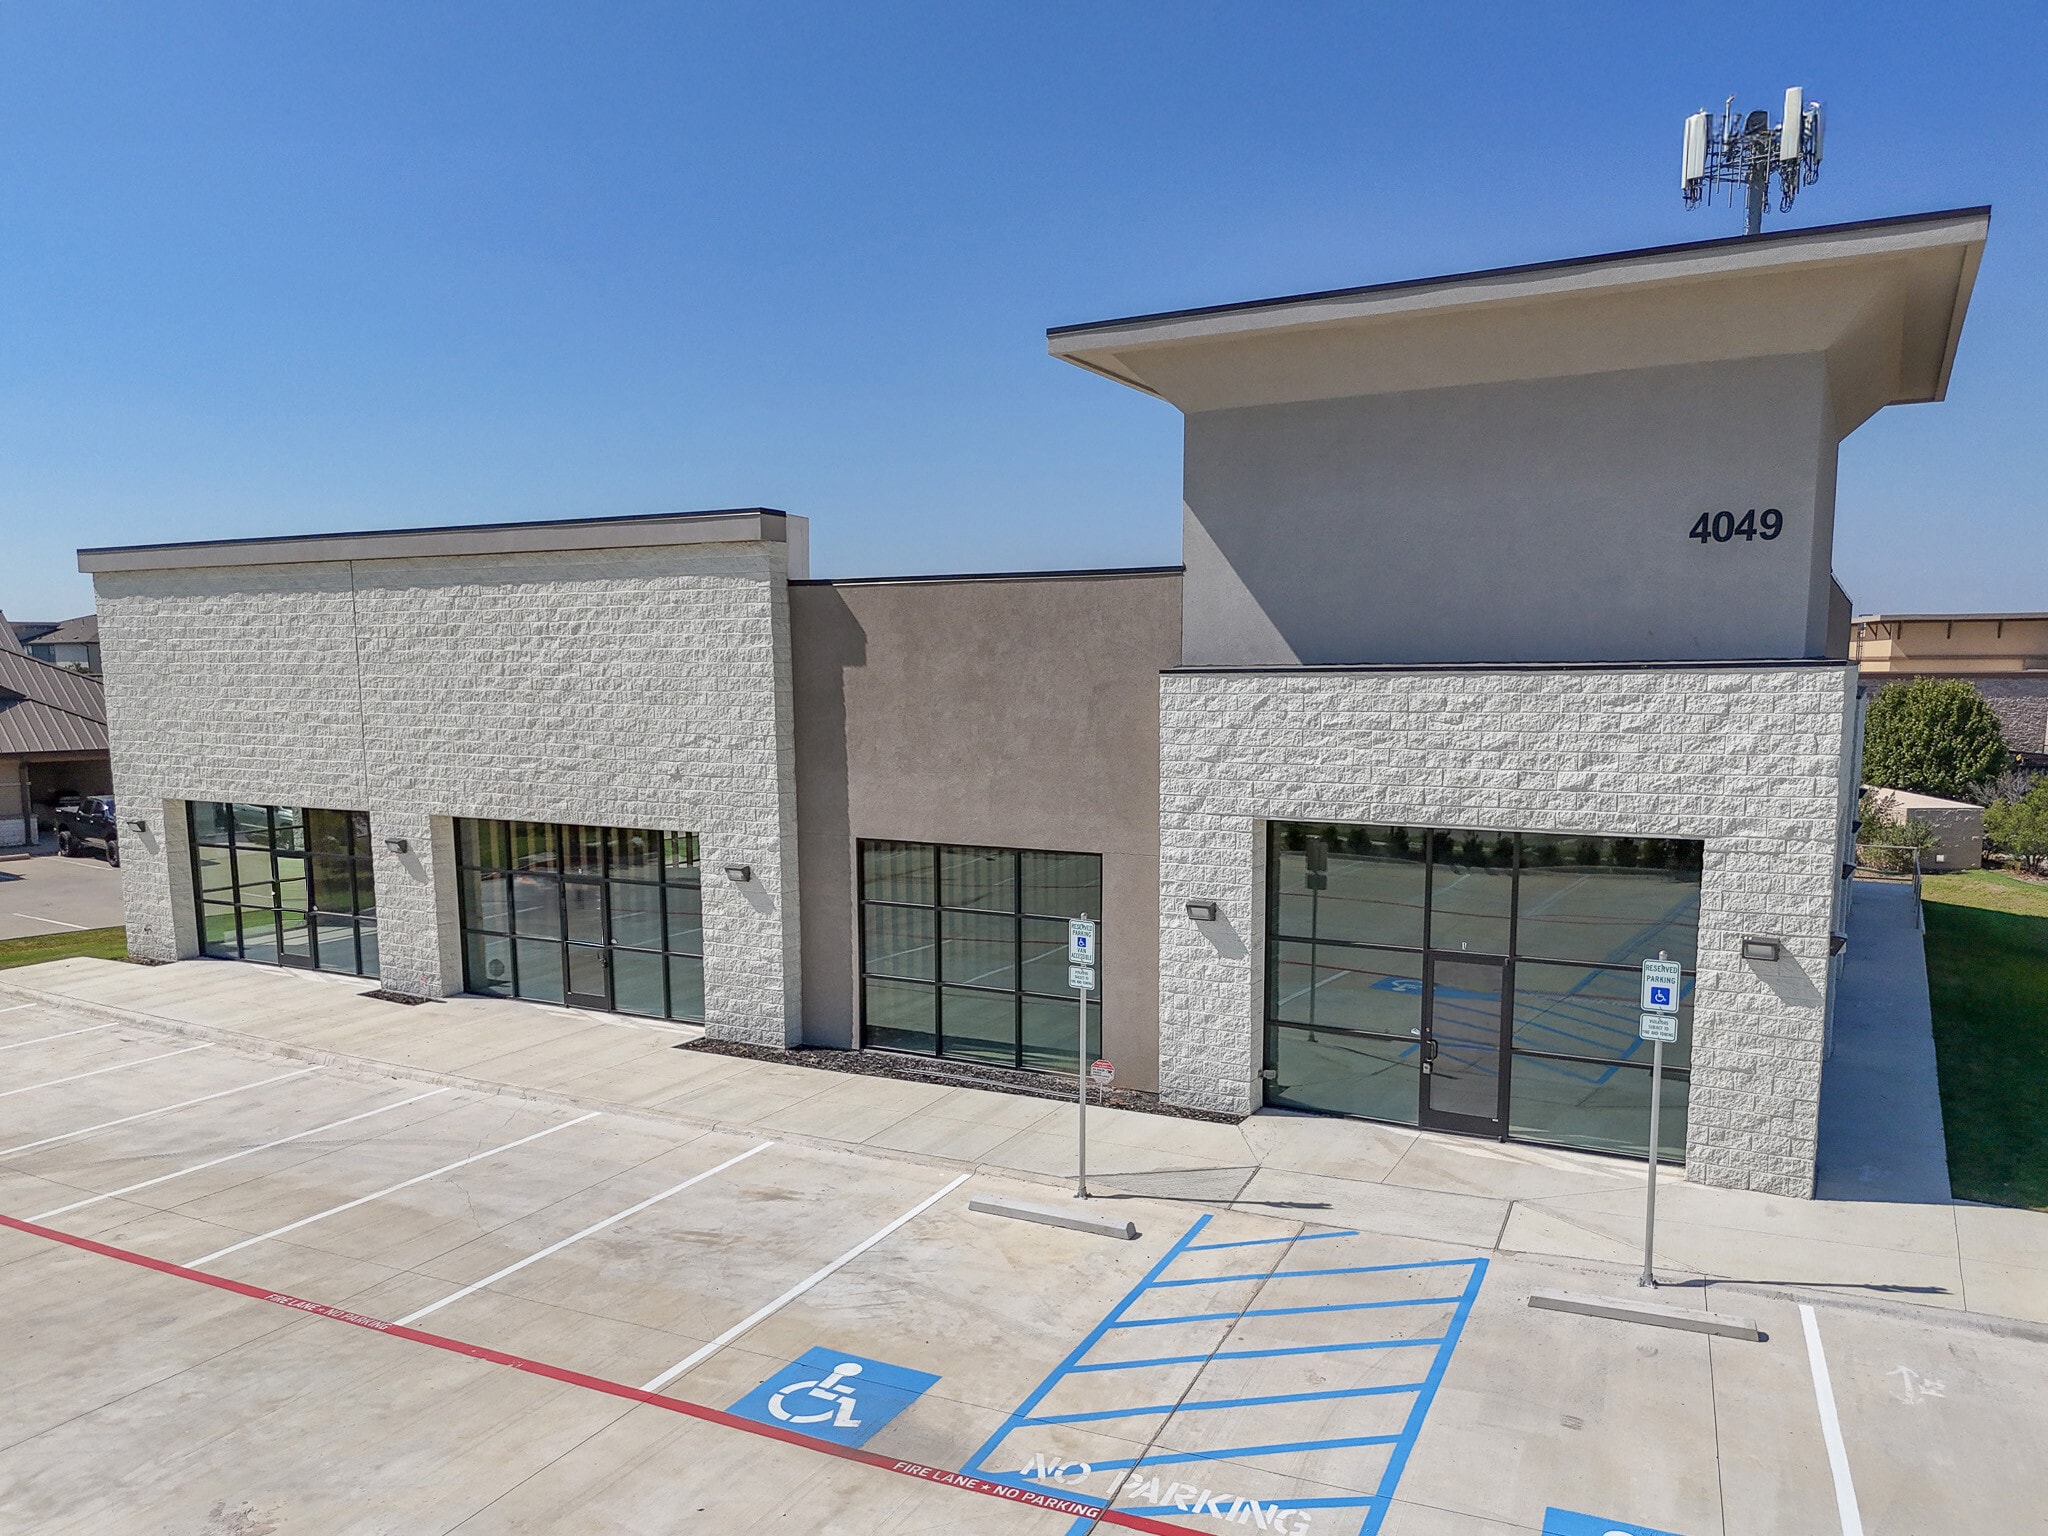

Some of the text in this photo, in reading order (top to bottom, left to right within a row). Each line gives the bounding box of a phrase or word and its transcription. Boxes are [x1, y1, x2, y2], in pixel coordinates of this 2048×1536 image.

[1689, 508, 1783, 544] 4049
[1645, 964, 1678, 974] RESERVED
[1646, 975, 1676, 985] PARKING
[264, 1293, 393, 1331] FIRE LANE NO PARKING
[892, 1461, 1101, 1519] FIRE LANE NO PARKING
[1019, 1452, 1312, 1536] NO PARKING
